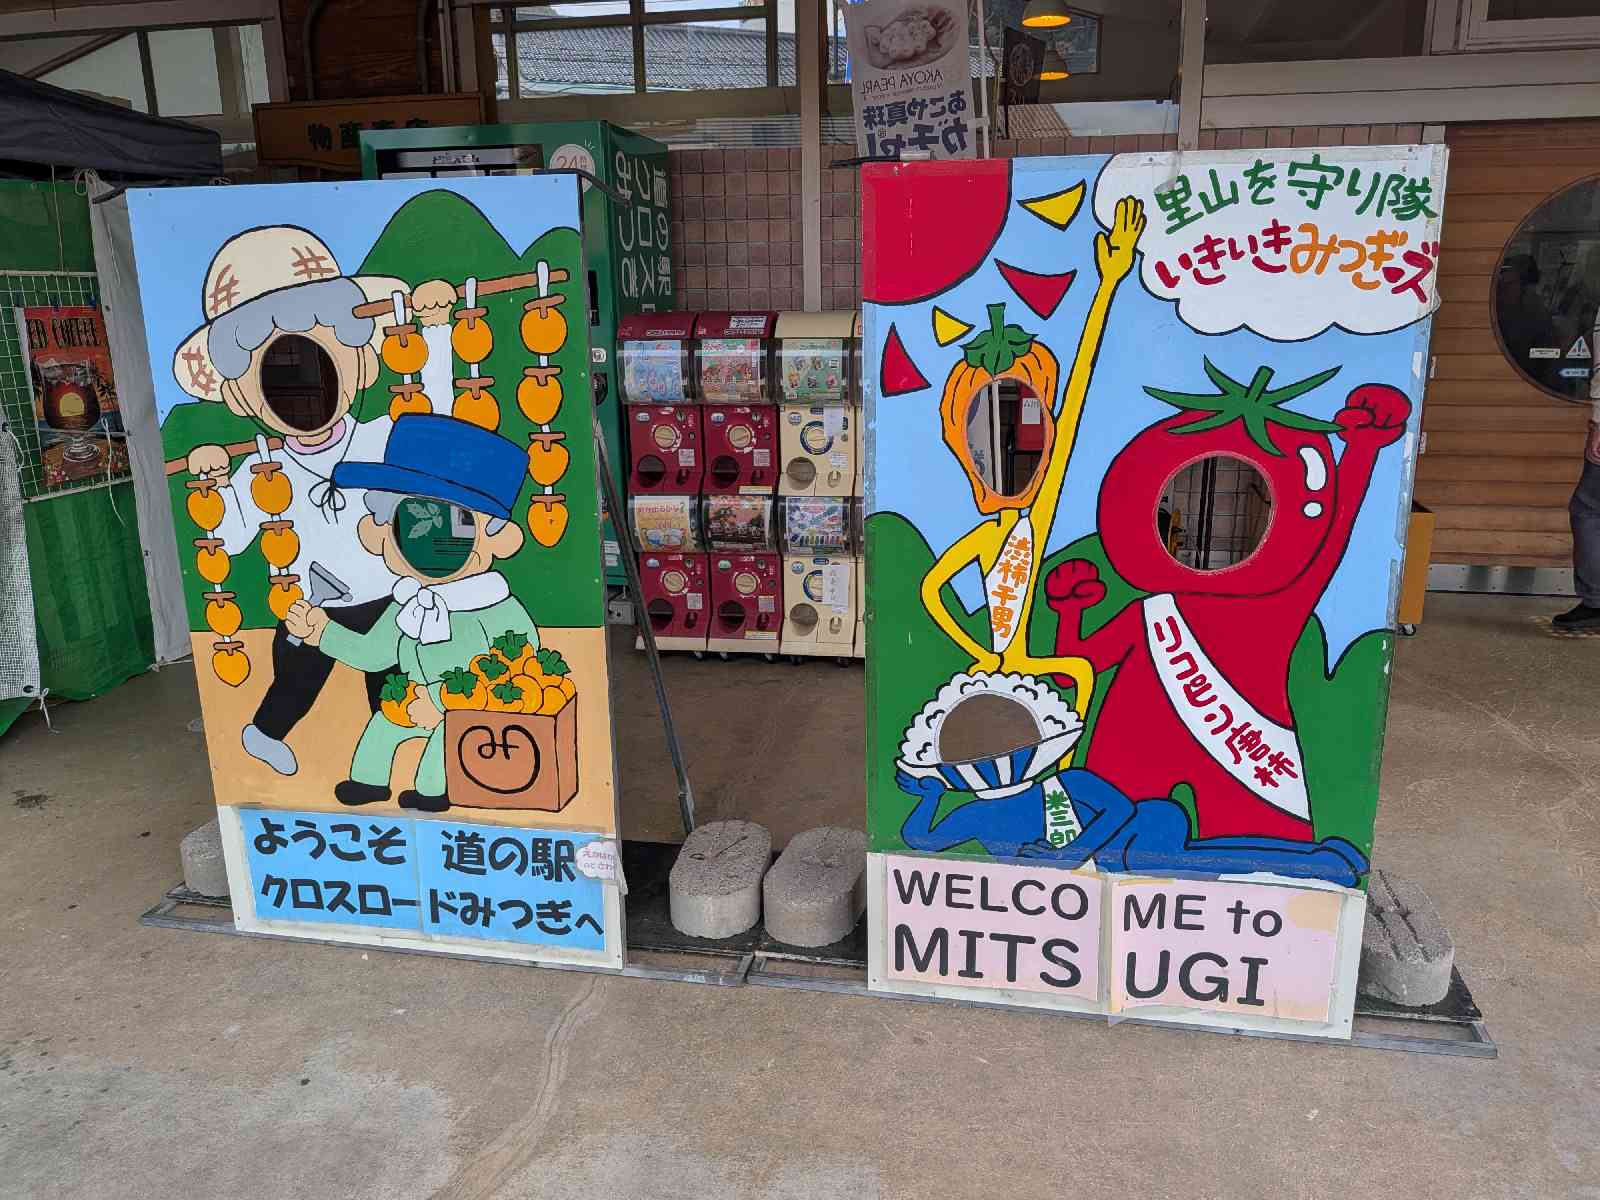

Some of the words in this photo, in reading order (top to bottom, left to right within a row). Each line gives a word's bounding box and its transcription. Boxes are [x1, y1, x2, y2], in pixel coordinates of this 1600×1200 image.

[615, 151, 639, 298] みつぎ
[1154, 154, 1438, 234] 里山を守り隊
[653, 165, 673, 296] 道の駅
[254, 818, 406, 865] ようこそ
[441, 830, 576, 882] 道の駅
[261, 874, 604, 936] クロスロードみつぎへ
[1227, 900, 1282, 937] to
